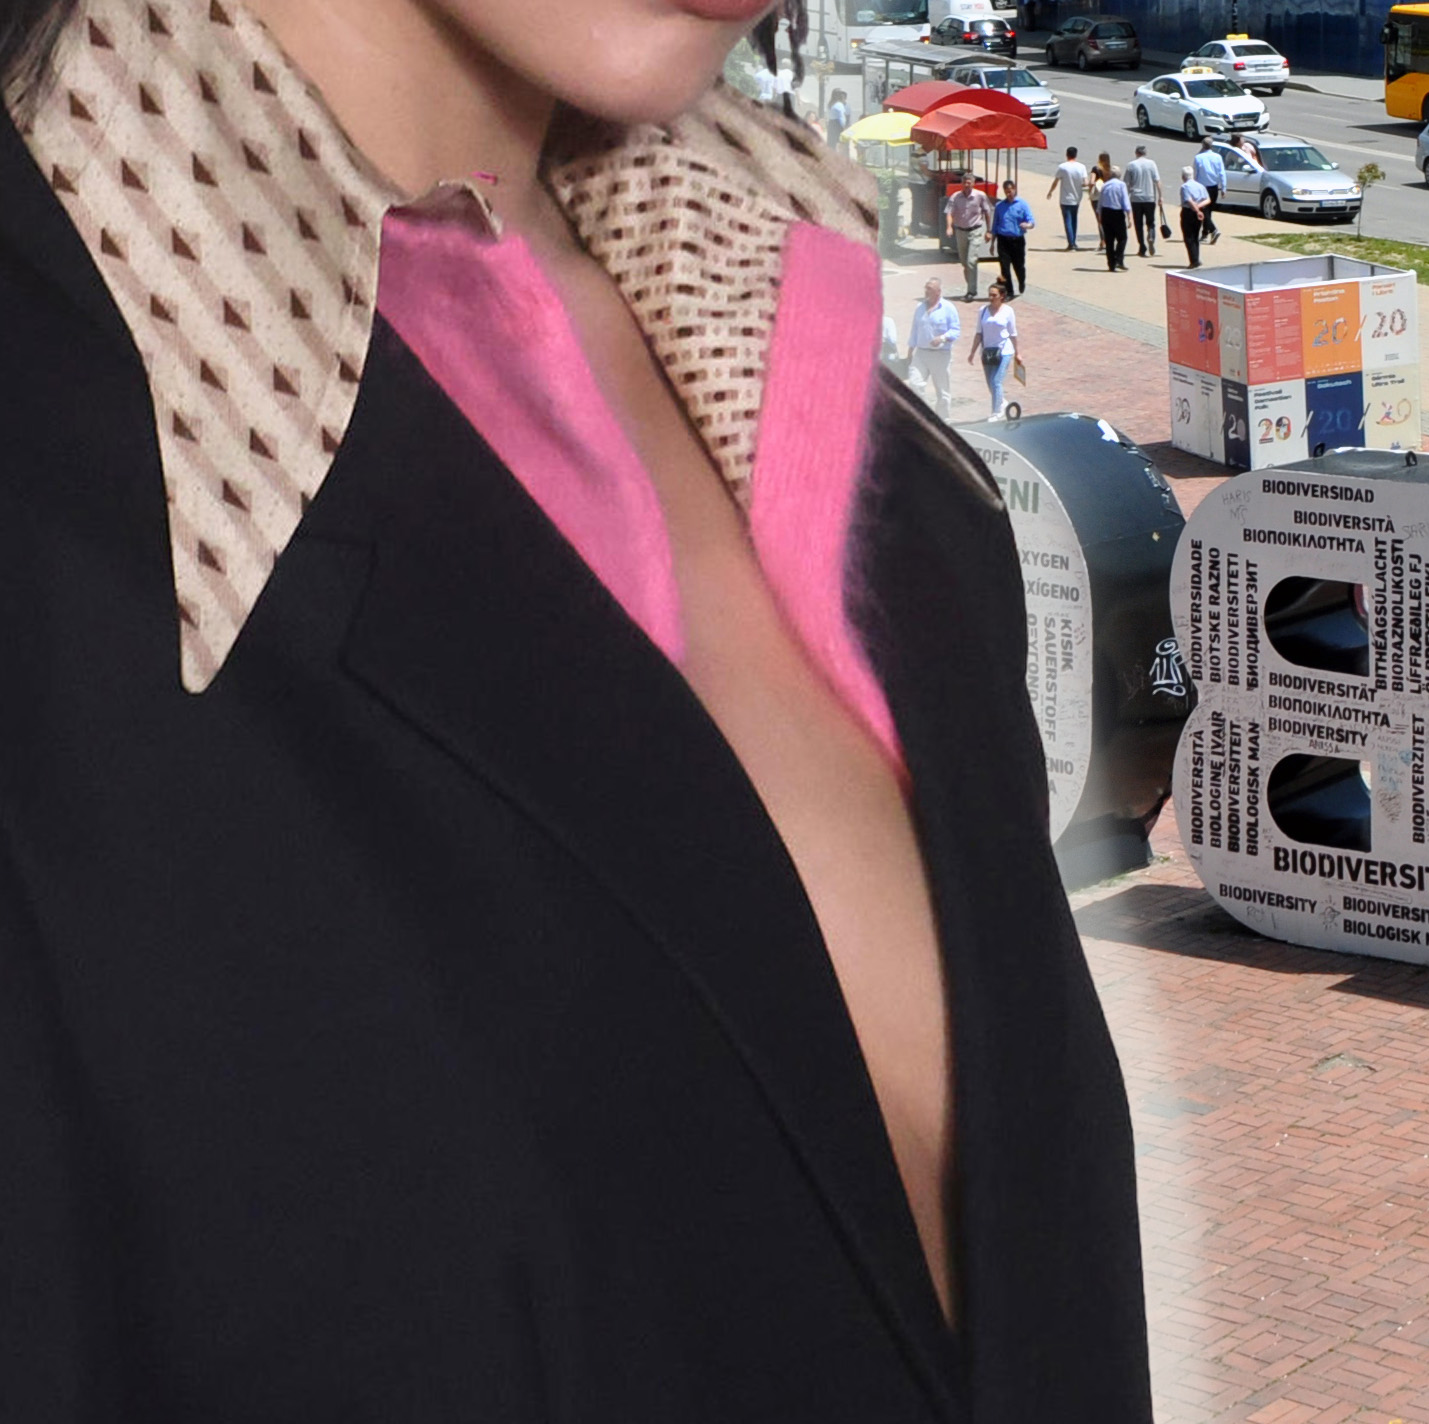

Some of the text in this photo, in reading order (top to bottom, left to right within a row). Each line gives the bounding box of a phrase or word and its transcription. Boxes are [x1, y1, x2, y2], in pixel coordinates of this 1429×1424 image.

[1262, 480, 1374, 503] BIODIVERSIDAD
[1293, 511, 1395, 533] BIODIVERSITÀ
[1021, 550, 1069, 570] XYGEN
[1209, 547, 1220, 605] RAZNO
[1026, 578, 1080, 602] XÍGENO
[1191, 539, 1203, 680] BIODIVERSIDADE
[1227, 553, 1239, 686] BIODIVERSITETI
[1061, 619, 1073, 672] KISIK
[1044, 617, 1057, 742] SAUERSTOFF
[1269, 673, 1377, 703] BIODIVERSITÄT
[1269, 717, 1368, 746] BIODIVERSITY
[1228, 721, 1242, 853] BIODIVERSITEIT
[1246, 722, 1260, 856] BIOLOGISK MAN
[1412, 714, 1425, 844] BIODIVERZITET
[1219, 884, 1317, 914] BIODIVERSITY
[1343, 919, 1420, 945] BIOLOGISK
